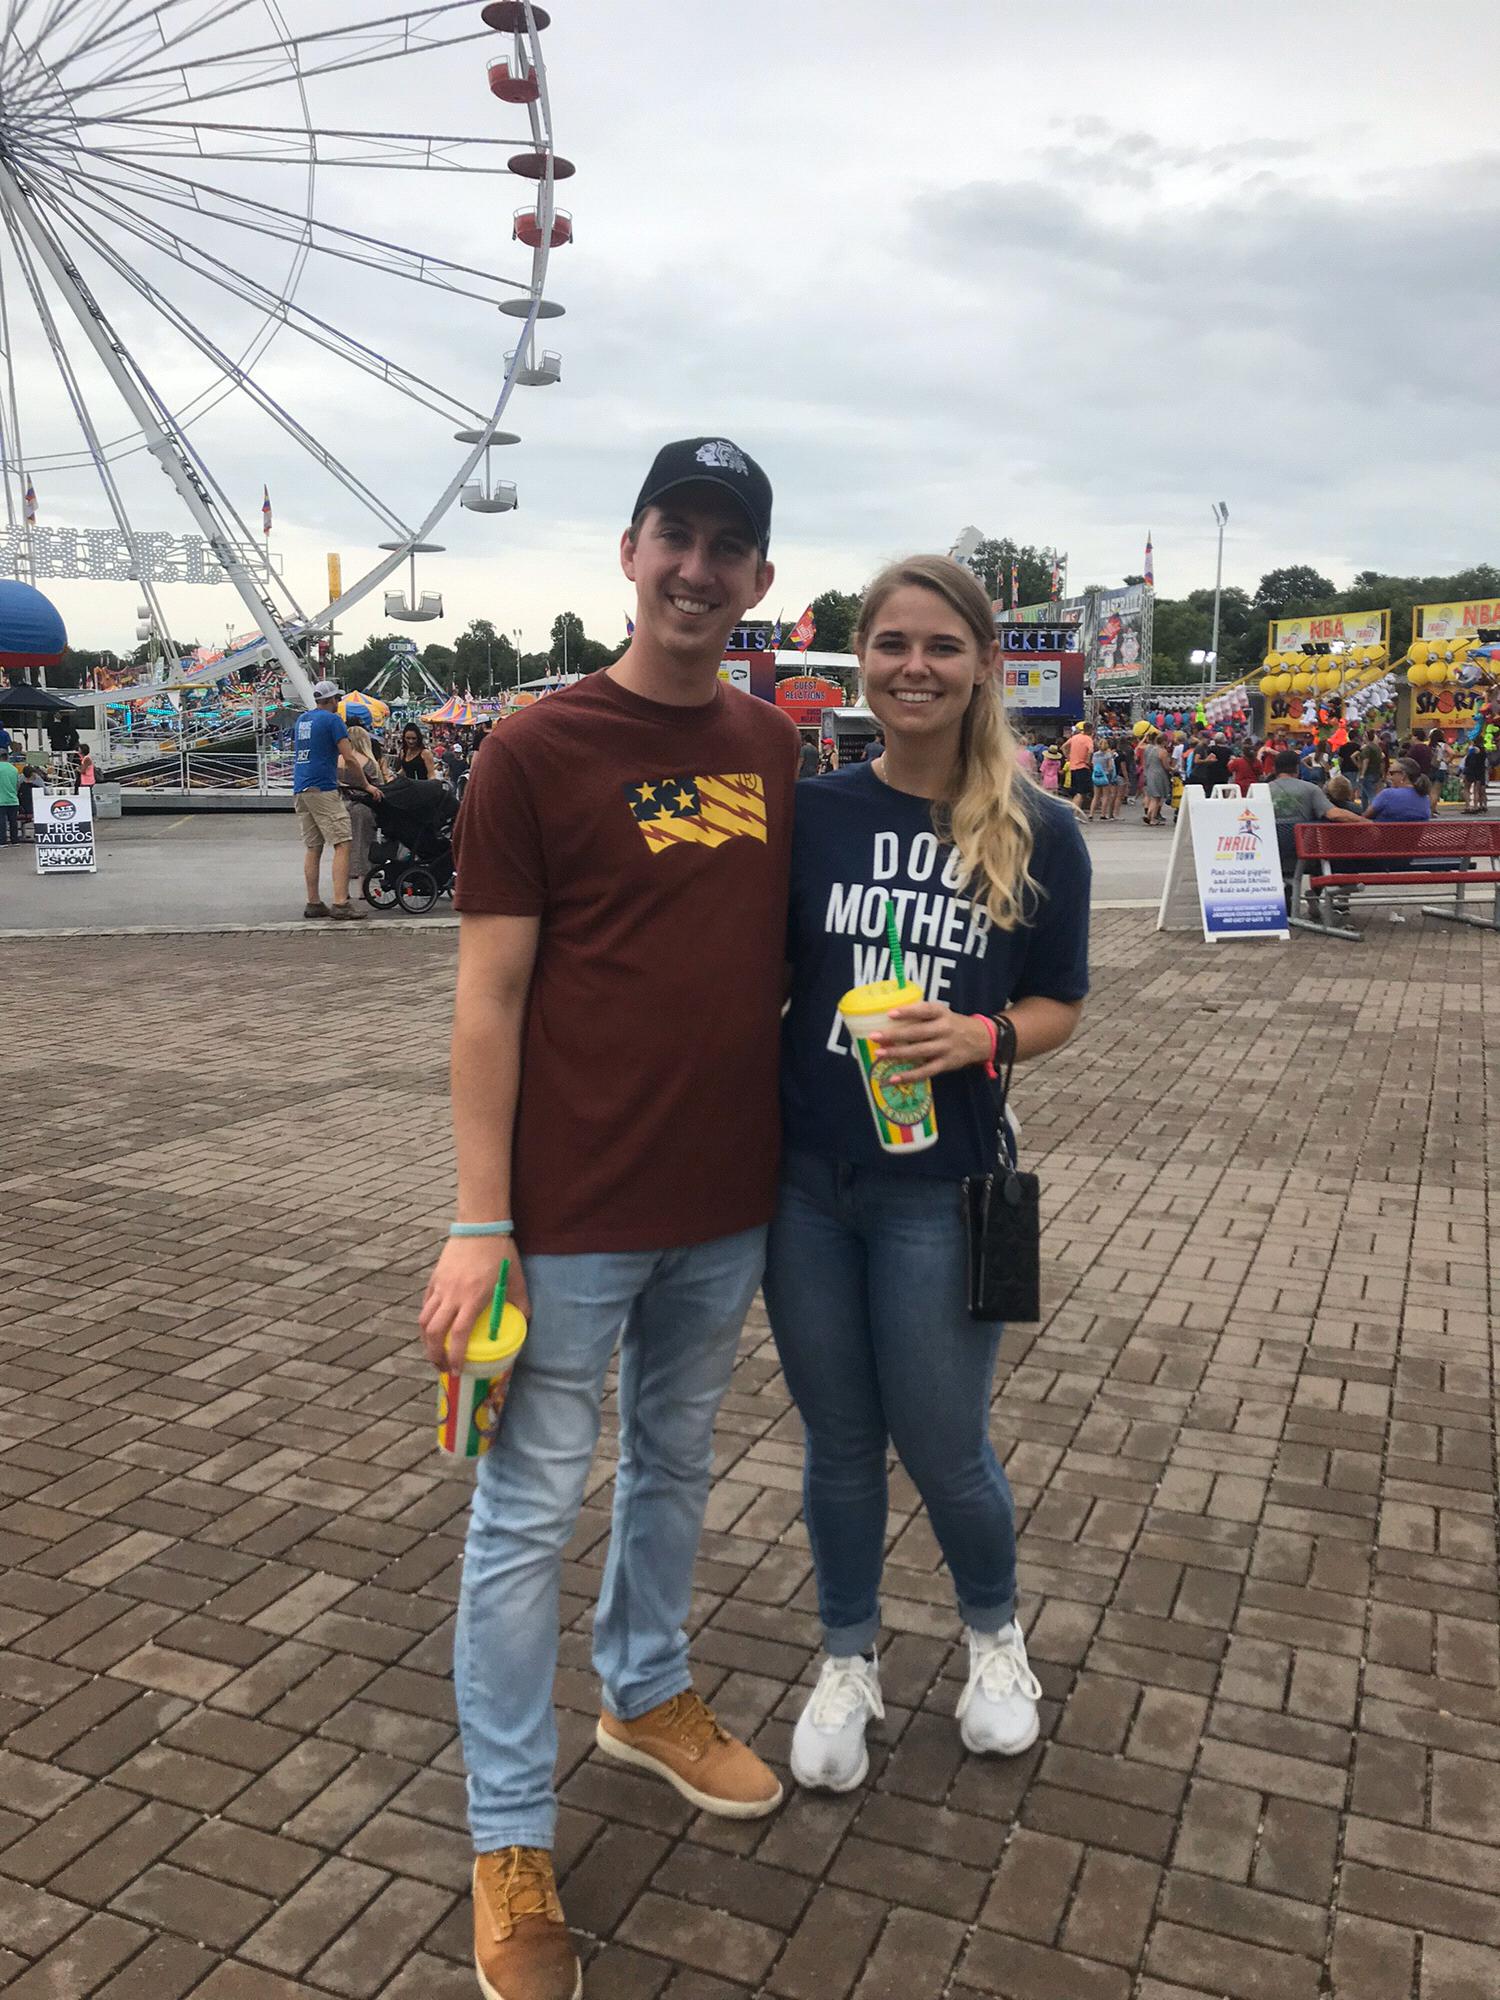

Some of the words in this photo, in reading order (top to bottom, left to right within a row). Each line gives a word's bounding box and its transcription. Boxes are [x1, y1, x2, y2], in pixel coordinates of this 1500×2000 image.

[1309, 616, 1344, 640] NBA
[1001, 630, 1075, 651] ICKETS
[794, 682, 817, 690] GUEST
[785, 690, 825, 701] RELATIONS
[47, 822, 80, 833] FREE
[35, 832, 93, 843] TATTOOS
[1216, 836, 1257, 851] THRILL
[48, 848, 92, 857] WOODY
[1235, 852, 1255, 860] TOWN
[48, 856, 92, 865] SHOW
[825, 882, 990, 959] MOTHER
